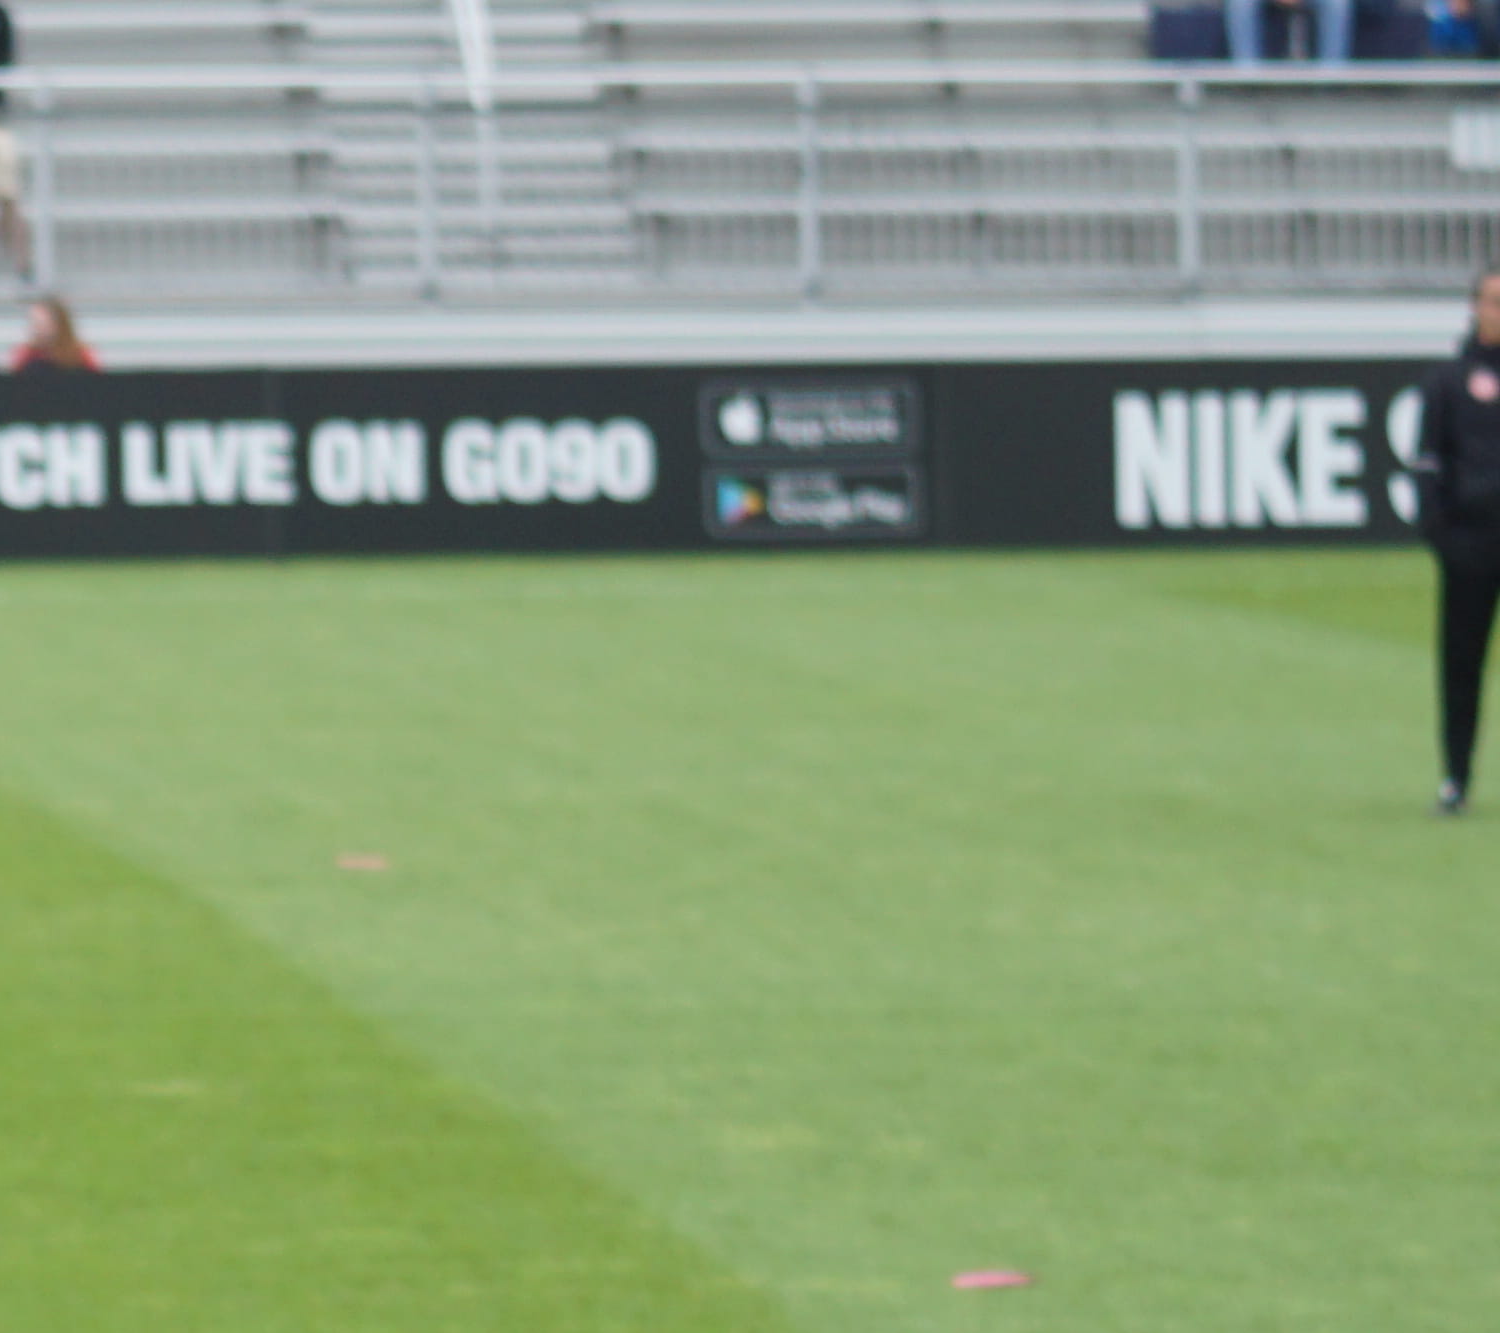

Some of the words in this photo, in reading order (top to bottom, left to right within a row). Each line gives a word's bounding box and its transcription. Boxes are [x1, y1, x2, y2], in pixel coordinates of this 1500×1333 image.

[122, 421, 294, 506] LIVE
[309, 419, 428, 505] ON
[1114, 388, 1369, 529] NIKE
